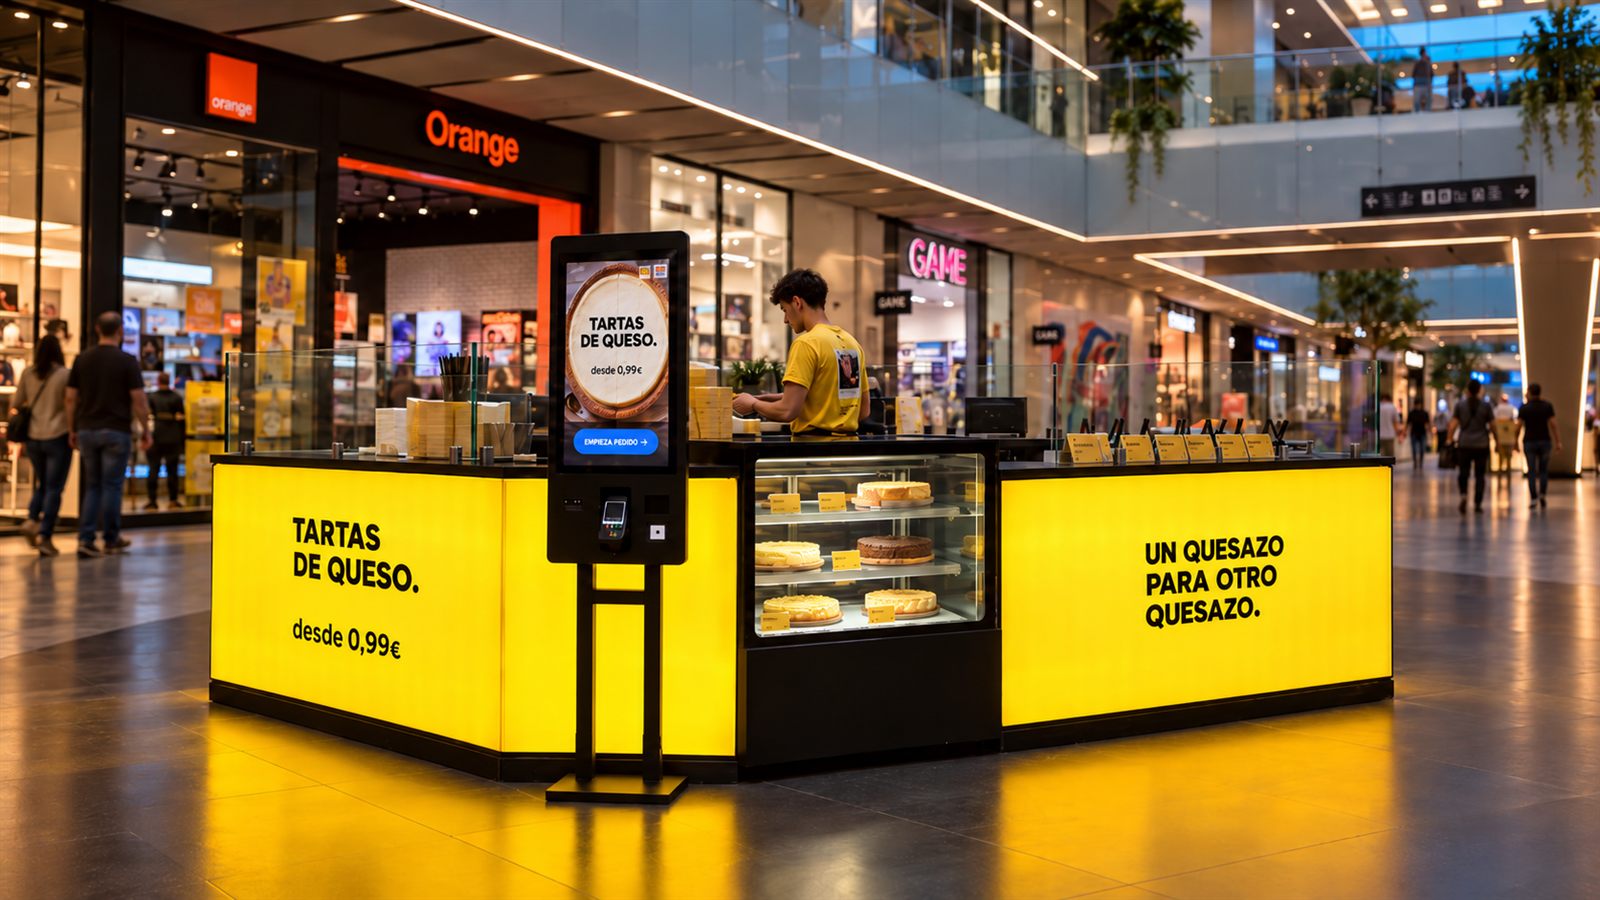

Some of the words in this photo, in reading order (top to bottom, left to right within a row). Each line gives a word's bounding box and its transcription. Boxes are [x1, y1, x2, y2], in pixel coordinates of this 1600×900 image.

[212, 97, 252, 117] orange
[425, 110, 519, 167] Orange
[909, 238, 967, 286] GAME
[878, 296, 906, 309] GAME
[589, 316, 644, 330] TARTAS
[581, 334, 599, 348] DE
[602, 333, 657, 348] QUESO.
[591, 366, 616, 375] desde
[617, 365, 643, 376] 0,99€
[293, 517, 380, 551] TARTAS
[1146, 541, 1176, 565] UN
[1183, 535, 1284, 563] QUESAZO
[293, 552, 321, 580] DE
[328, 556, 419, 593] QUESO.
[1147, 570, 1209, 596] PARA
[1216, 565, 1277, 590] OTRO
[1146, 596, 1260, 629] QUESAZO.
[293, 618, 343, 648] desde
[348, 628, 401, 659] 0,99€
